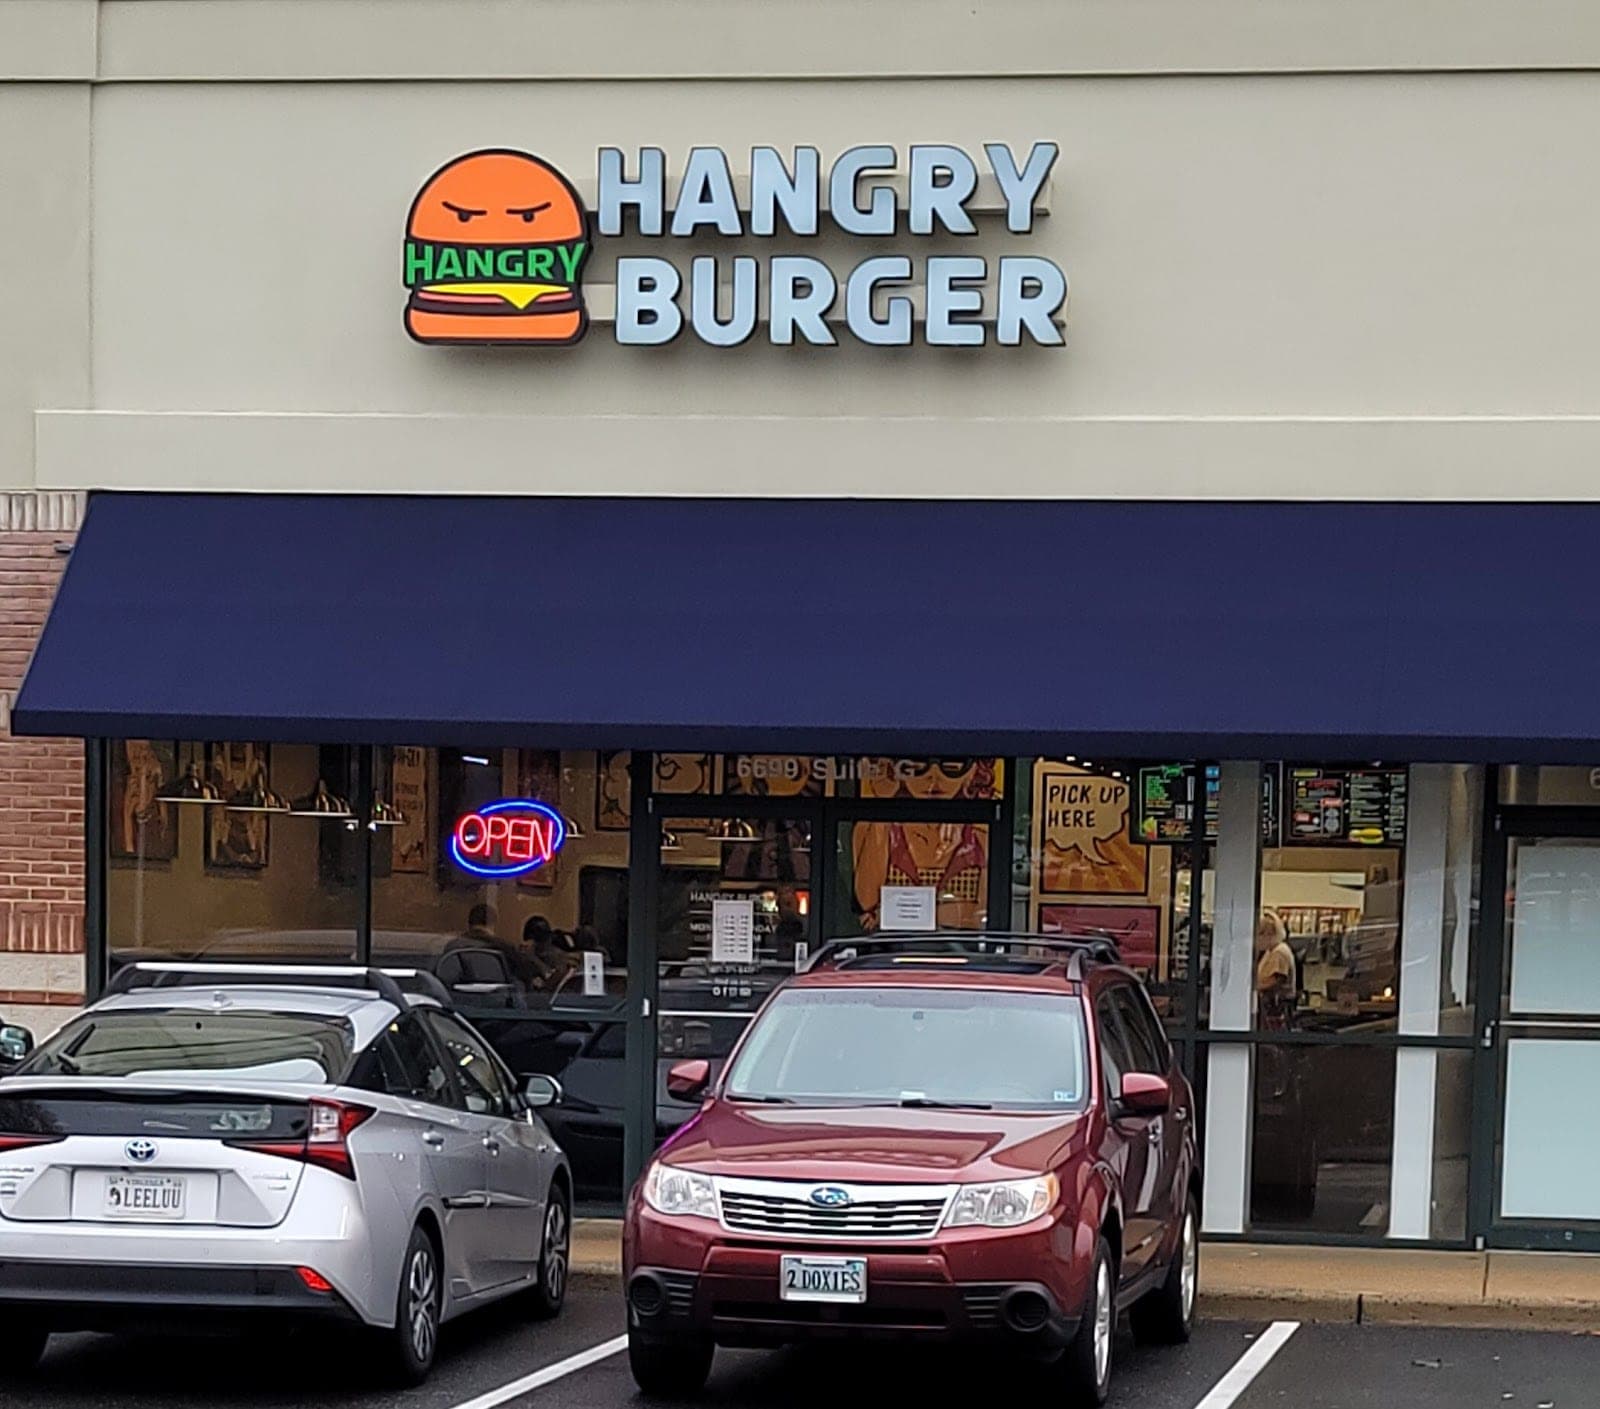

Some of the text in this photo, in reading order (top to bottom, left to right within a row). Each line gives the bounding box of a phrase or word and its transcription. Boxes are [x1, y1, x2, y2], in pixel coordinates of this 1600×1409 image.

[598, 142, 1060, 237] HANGRY
[405, 242, 585, 286] HANGRY
[615, 256, 1067, 347] BURGER
[737, 757, 799, 779] 6699
[1049, 784, 1092, 804] PICK
[1099, 785, 1126, 805] UP
[1048, 809, 1096, 828] HERE
[457, 813, 554, 861] OPEN
[124, 1187, 181, 1209] LEELUU
[786, 1269, 860, 1292] 2 DOXIES
